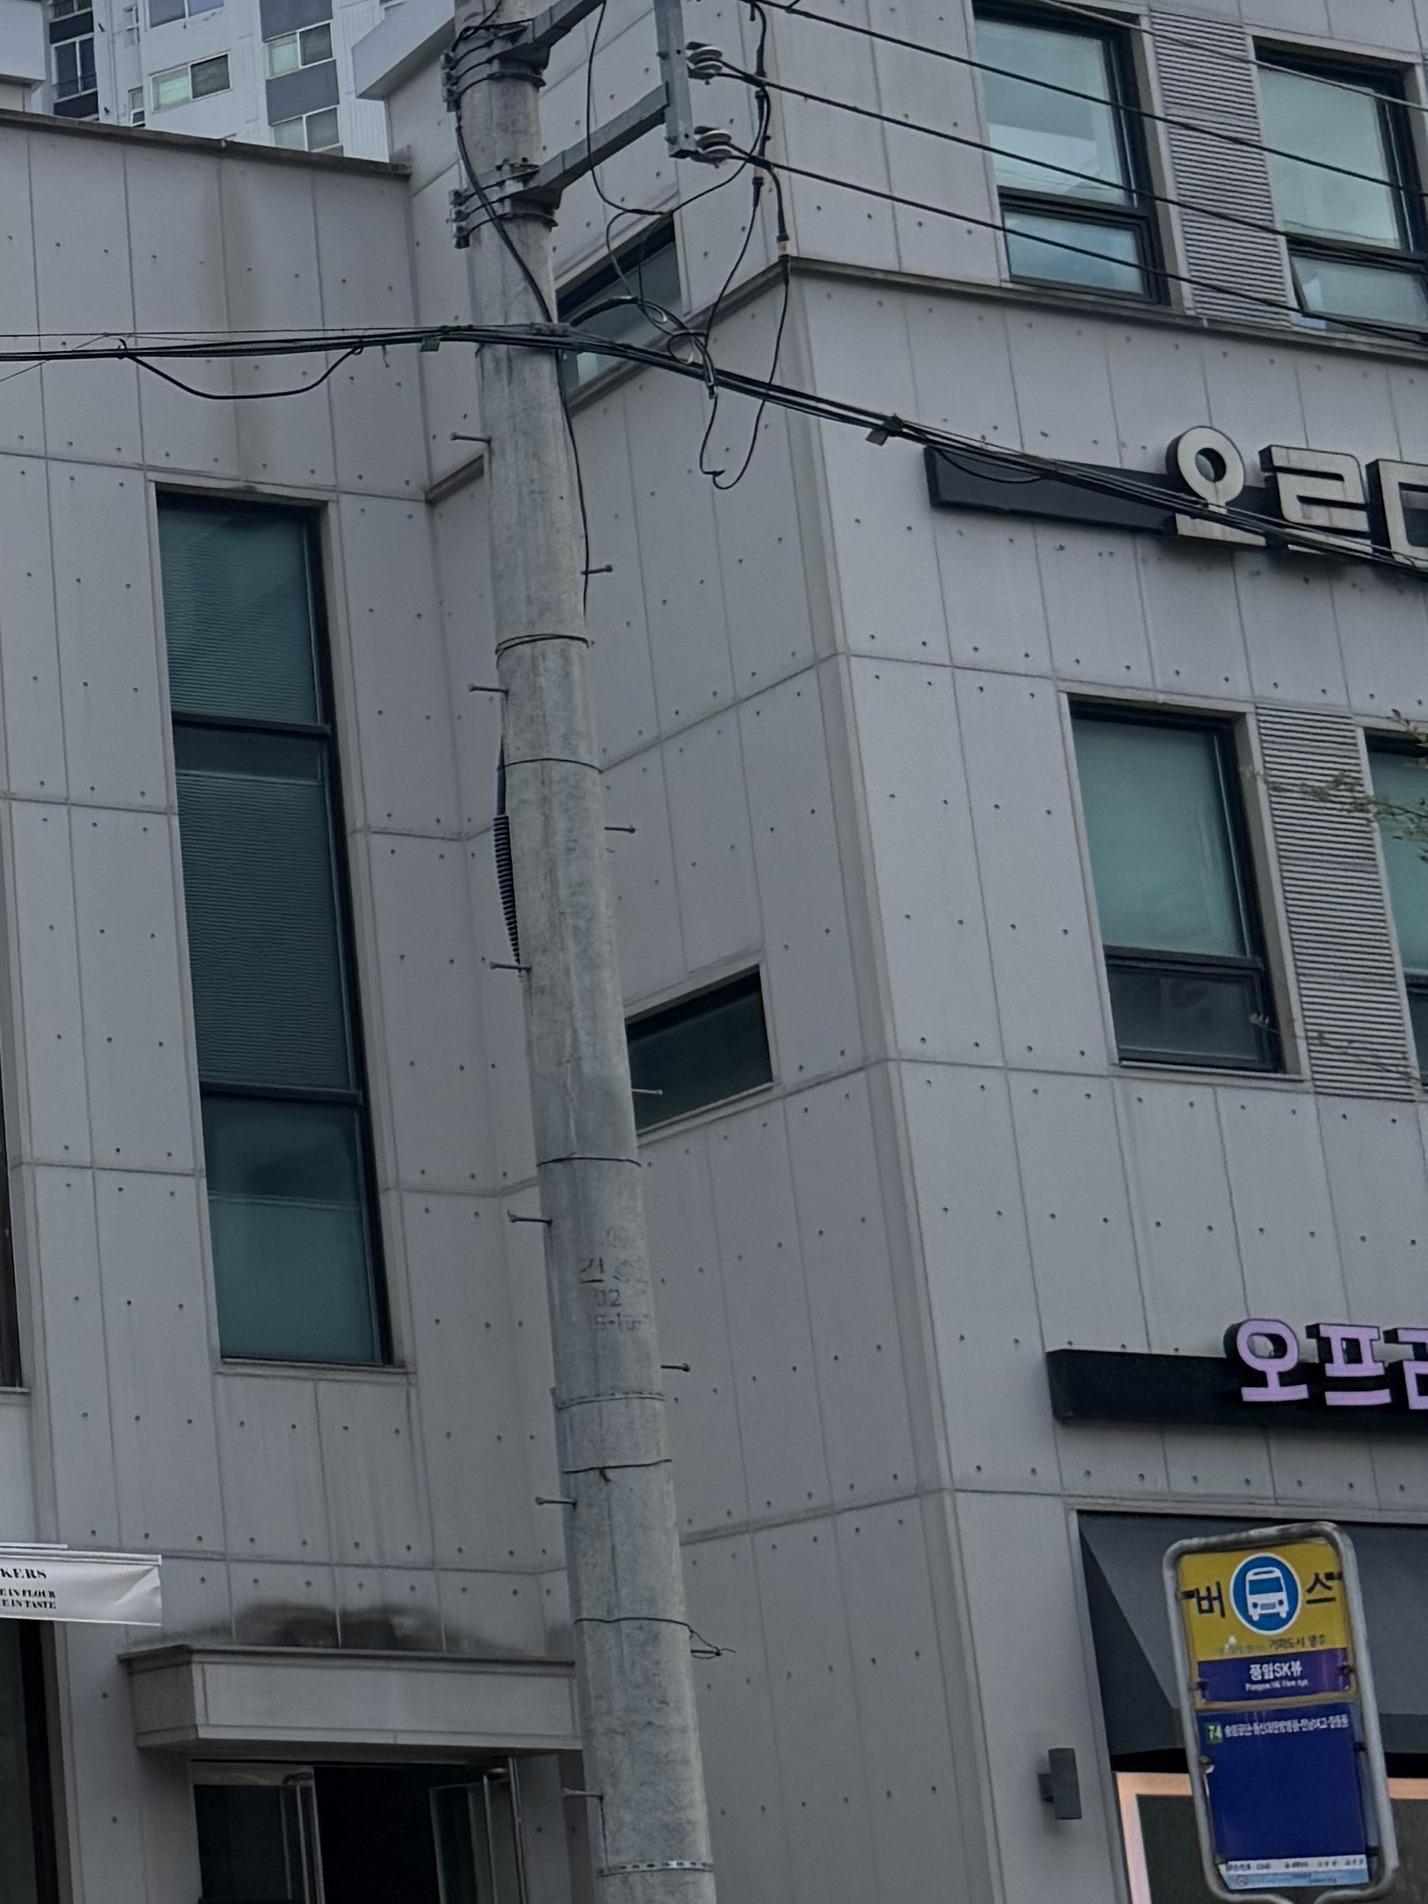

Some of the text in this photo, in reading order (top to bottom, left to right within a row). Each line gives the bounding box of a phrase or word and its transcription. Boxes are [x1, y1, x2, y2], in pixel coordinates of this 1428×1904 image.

[8, 1588, 20, 1597] IN
[22, 1589, 56, 1599] FLOUR
[11, 1599, 23, 1608] IN
[24, 1600, 57, 1609] TASTE
[1208, 1724, 1223, 1741] 74
